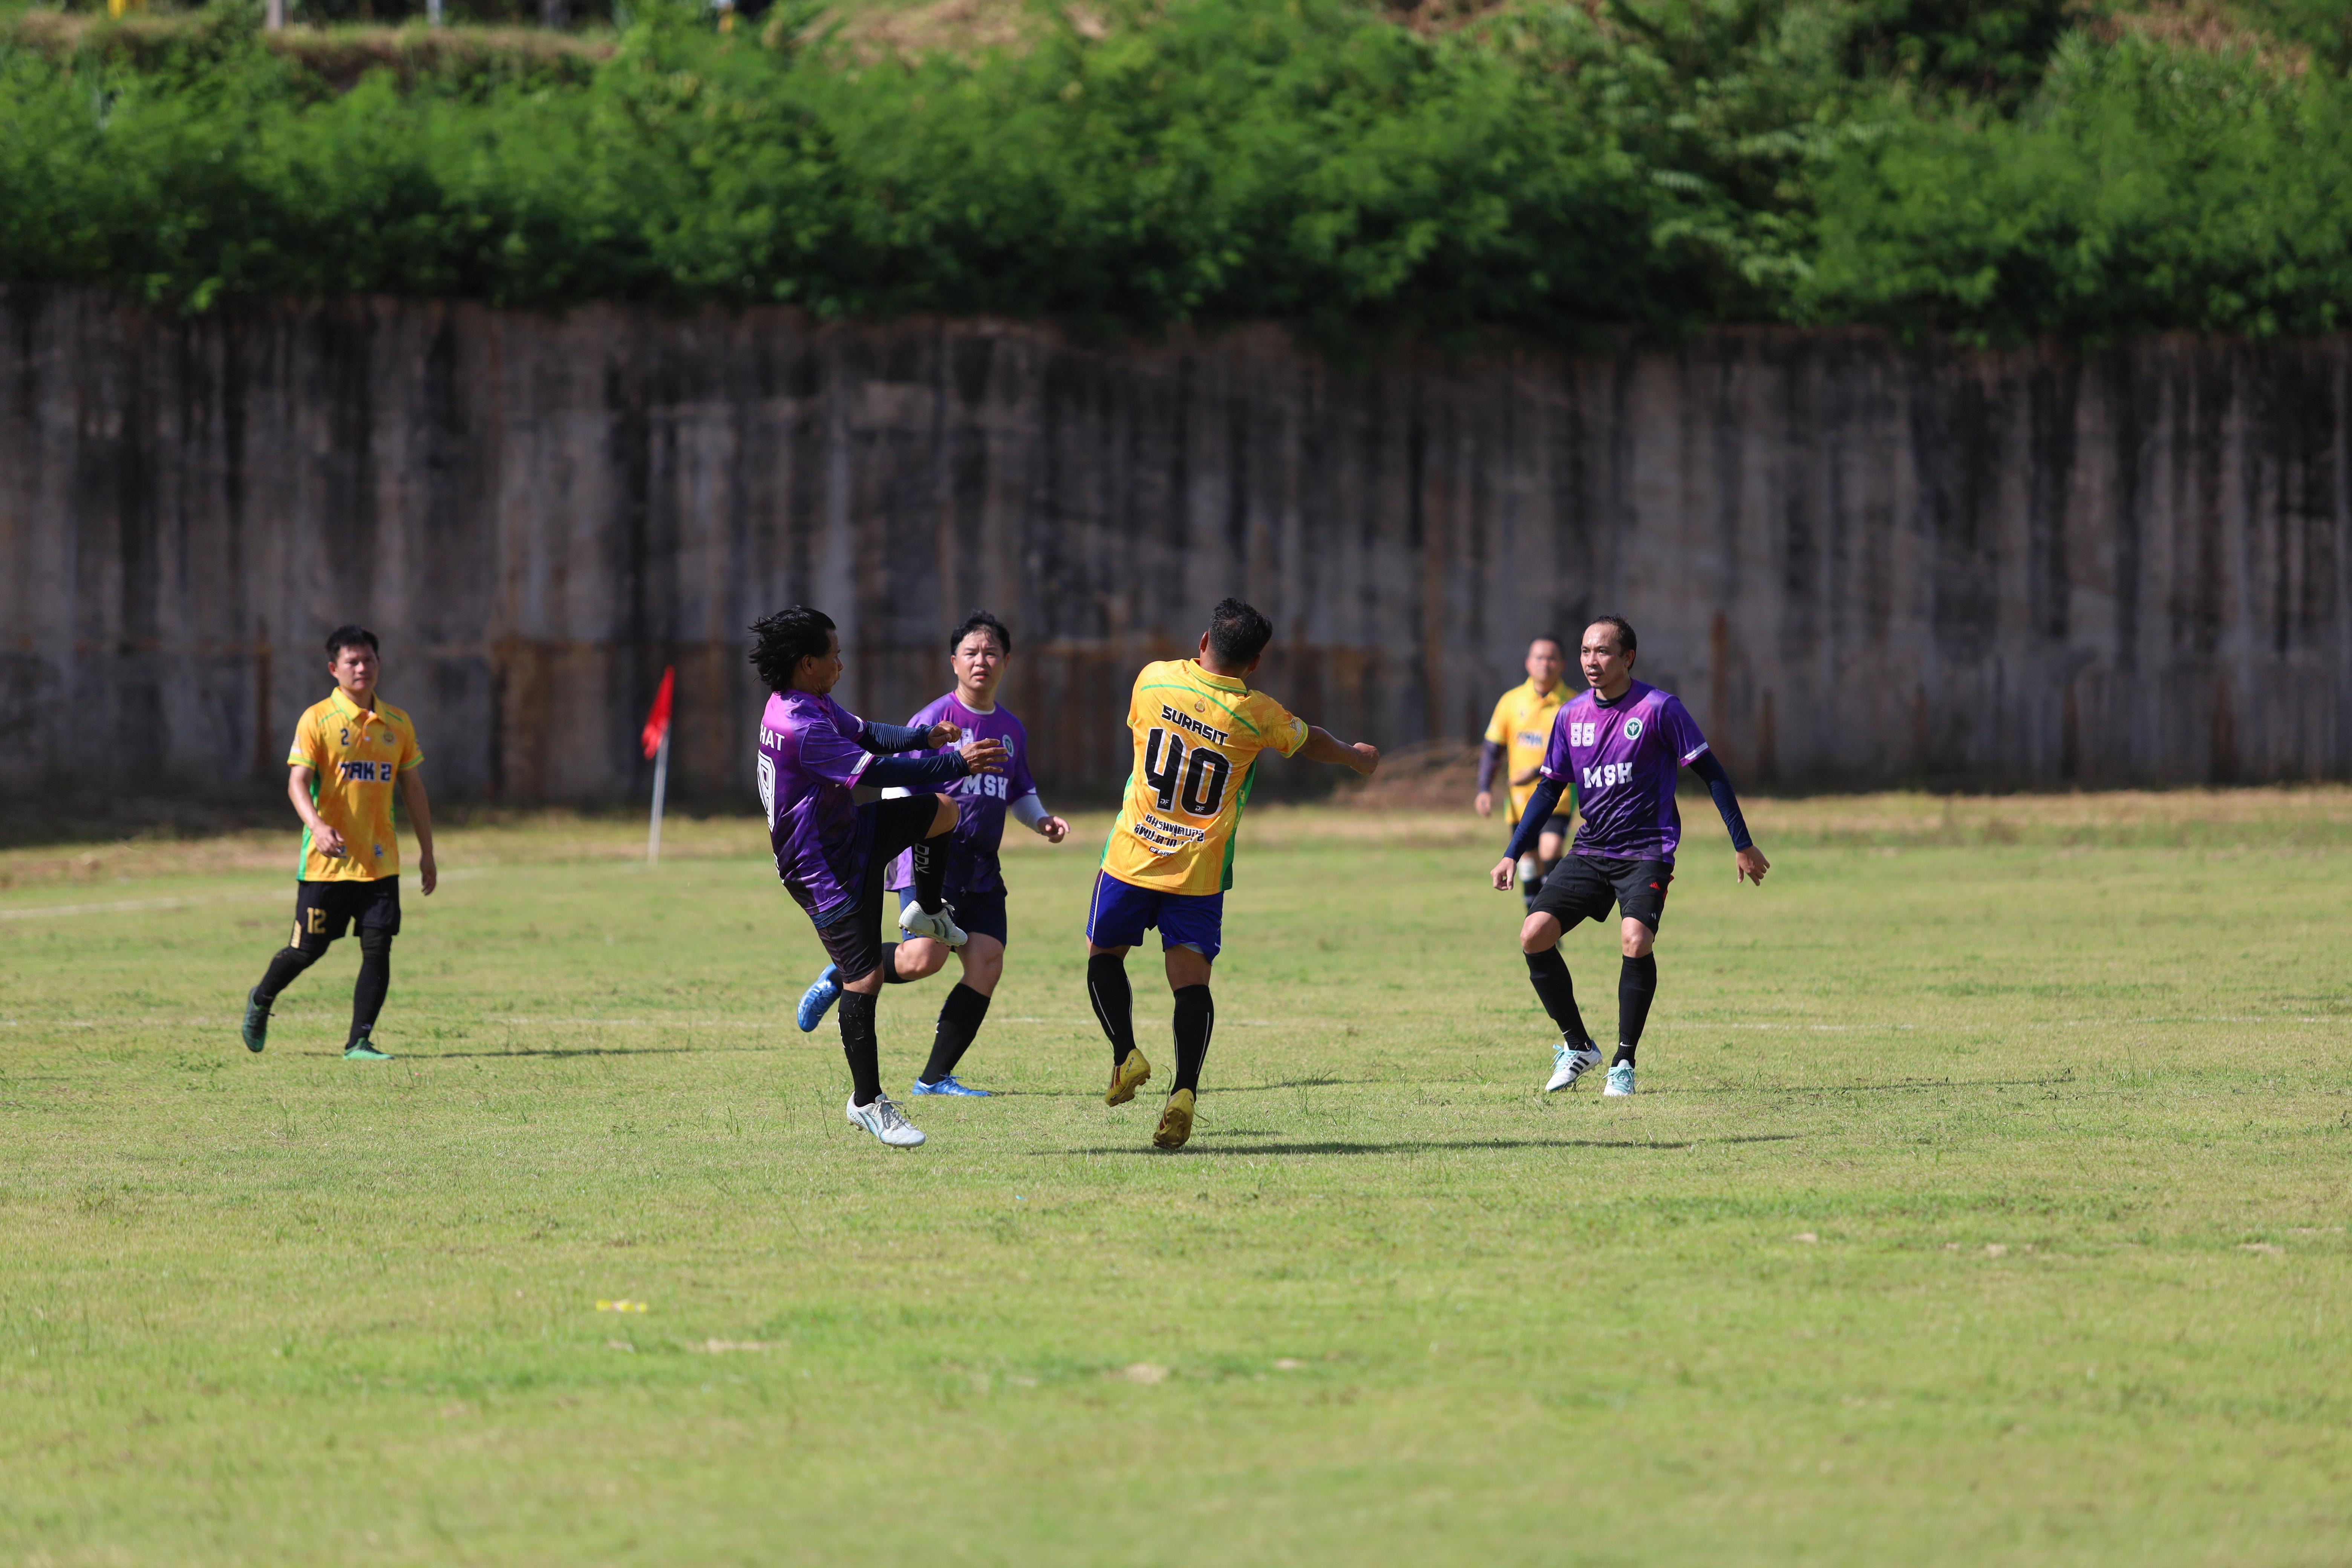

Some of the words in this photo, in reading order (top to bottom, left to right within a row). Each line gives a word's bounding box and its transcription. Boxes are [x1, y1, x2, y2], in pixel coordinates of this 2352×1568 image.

[341, 727, 349, 745] 2
[759, 724, 785, 751] HAT
[1161, 704, 1229, 745] SURASIT
[339, 761, 375, 781] TAK
[380, 762, 392, 781] 2
[1145, 727, 1233, 818] 40
[1583, 762, 1633, 789] MSH
[961, 773, 1009, 800] MSH
[307, 907, 326, 934] 12
